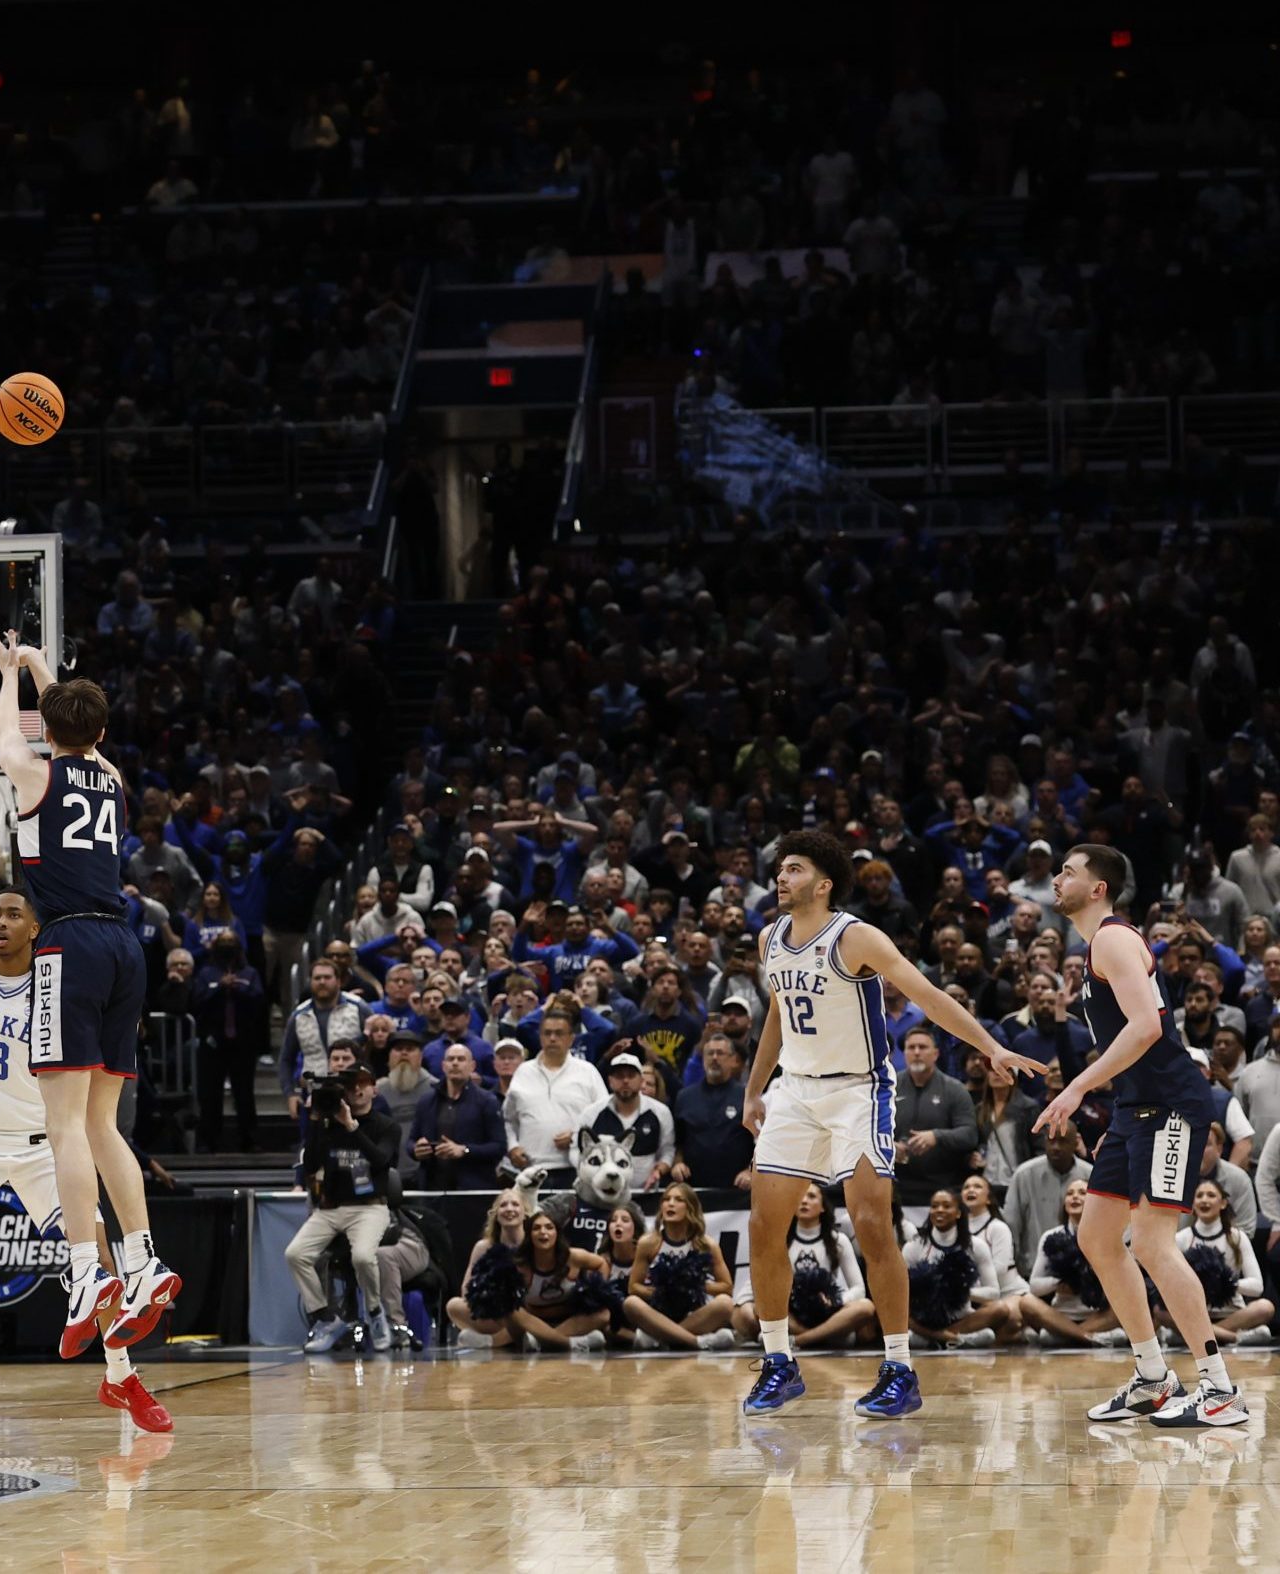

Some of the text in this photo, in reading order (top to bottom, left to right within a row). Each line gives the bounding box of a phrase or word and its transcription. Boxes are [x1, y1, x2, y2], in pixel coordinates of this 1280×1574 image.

[23, 387, 60, 423] Wilson
[15, 411, 45, 437] NCAA
[66, 766, 115, 793] MULLINS
[62, 792, 118, 856] 24
[769, 970, 828, 995] DUKE
[40, 962, 52, 1057] HUSKIES
[784, 996, 817, 1035] 12
